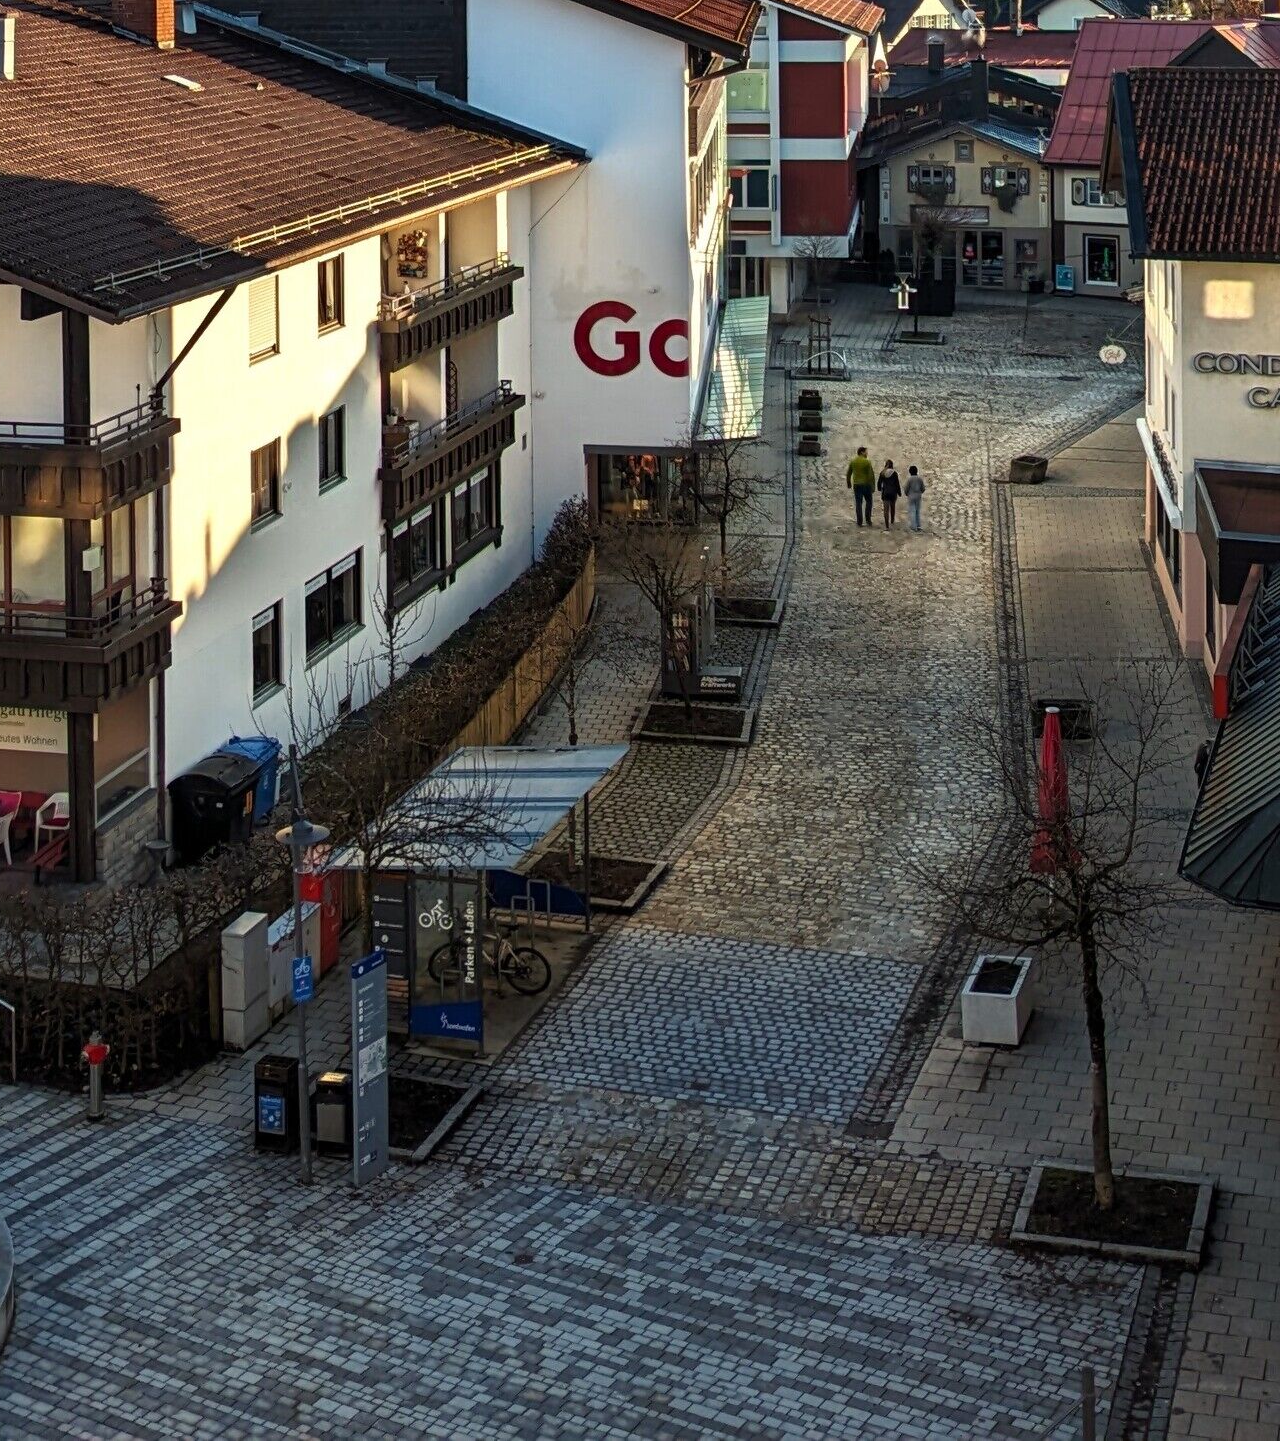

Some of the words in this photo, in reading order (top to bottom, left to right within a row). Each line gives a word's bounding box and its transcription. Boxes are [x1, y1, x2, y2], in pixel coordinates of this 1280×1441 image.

[23, 735, 58, 746] Wohnen
[464, 900, 475, 934] Laden
[465, 946, 475, 984] Parken
